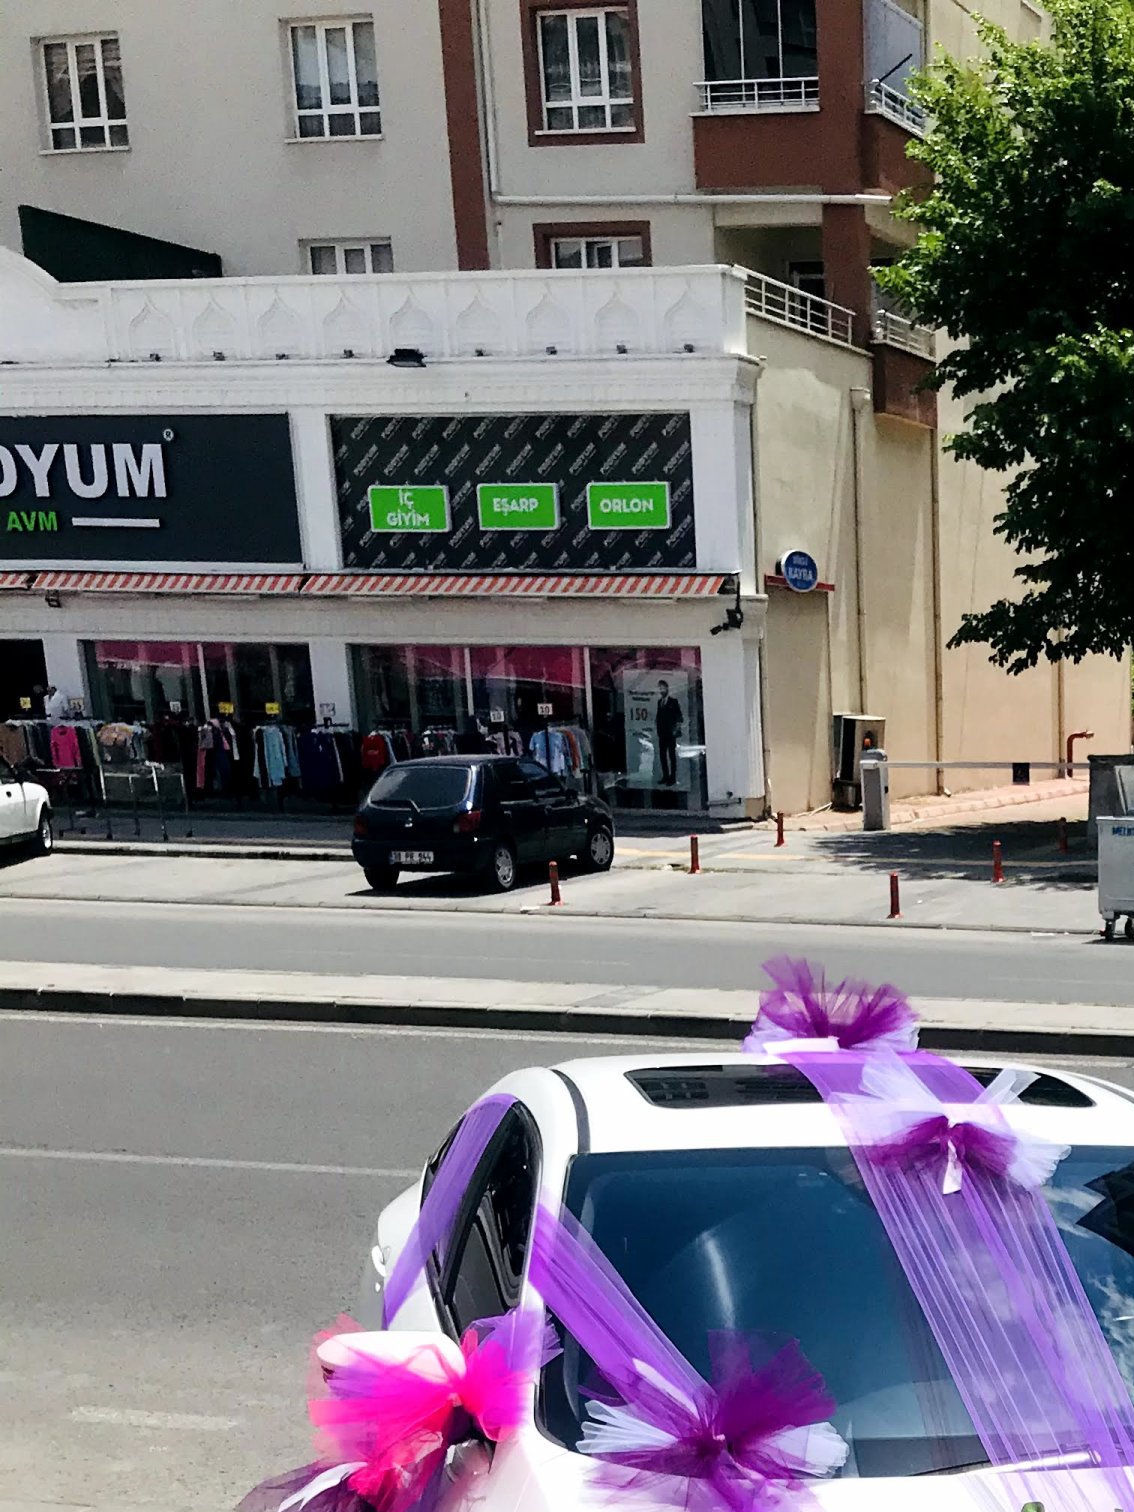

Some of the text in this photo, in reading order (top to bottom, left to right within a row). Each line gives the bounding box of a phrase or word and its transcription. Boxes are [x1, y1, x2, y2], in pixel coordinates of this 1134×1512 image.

[493, 497, 539, 516] EŞARP
[600, 498, 654, 513] ORLON
[7, 511, 58, 532] AVM
[386, 508, 430, 527] GİYİM
